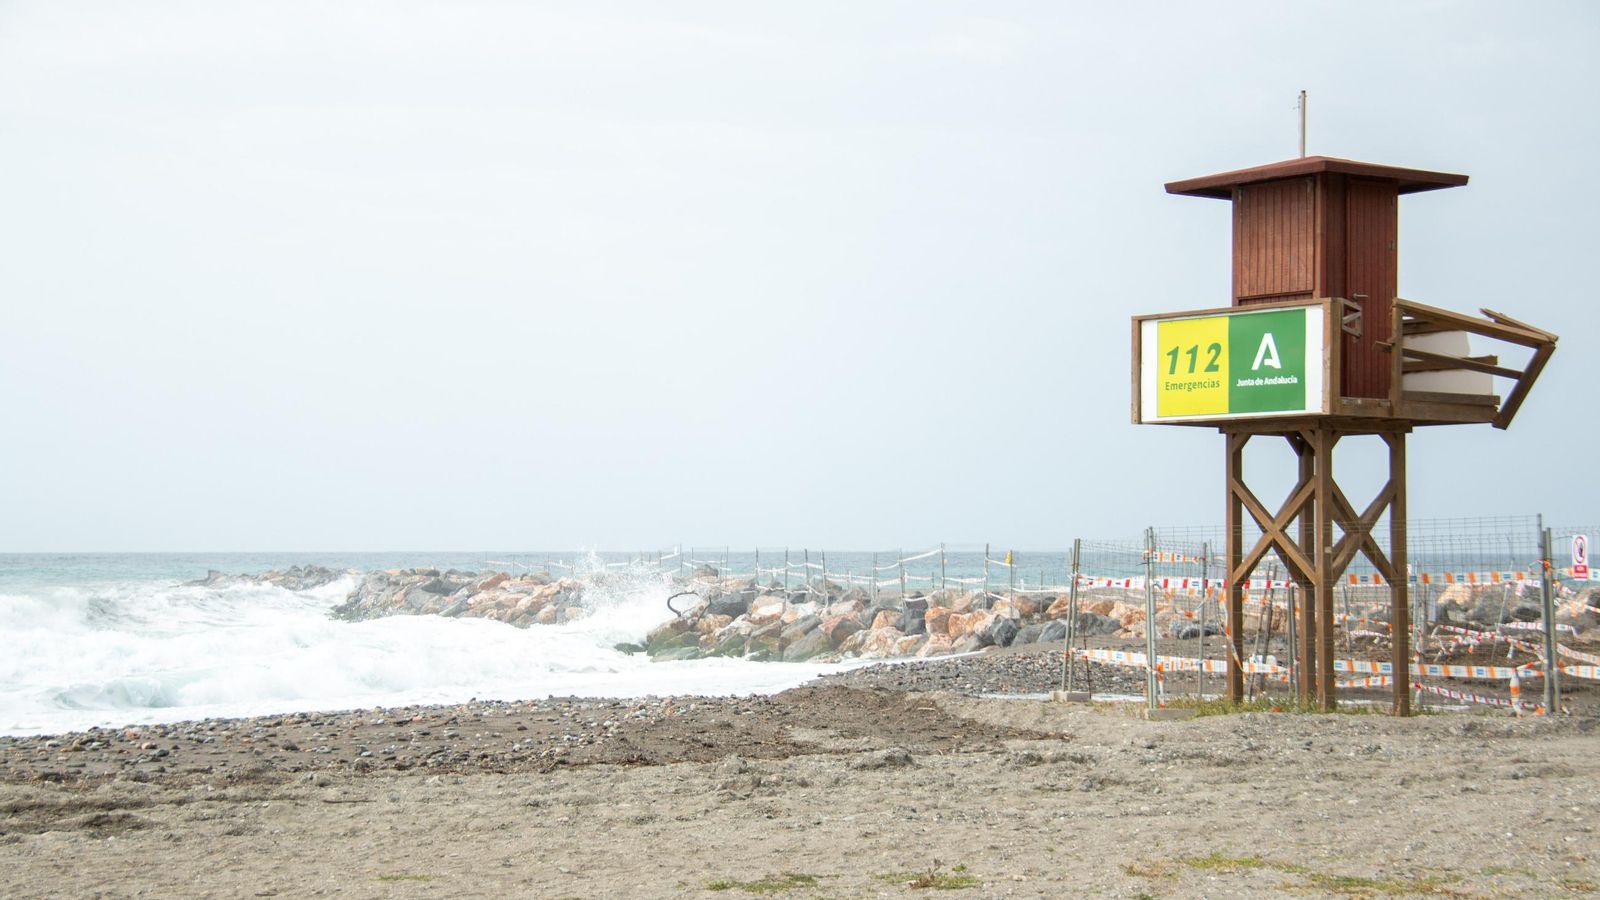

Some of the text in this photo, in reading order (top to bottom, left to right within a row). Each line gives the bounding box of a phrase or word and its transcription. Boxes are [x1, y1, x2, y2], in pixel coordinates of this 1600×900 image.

[1166, 342, 1222, 375] 112
[1251, 332, 1282, 370] A
[1165, 378, 1220, 392] Emergencias
[1236, 378, 1254, 387] Junta
[1254, 377, 1264, 386] de
